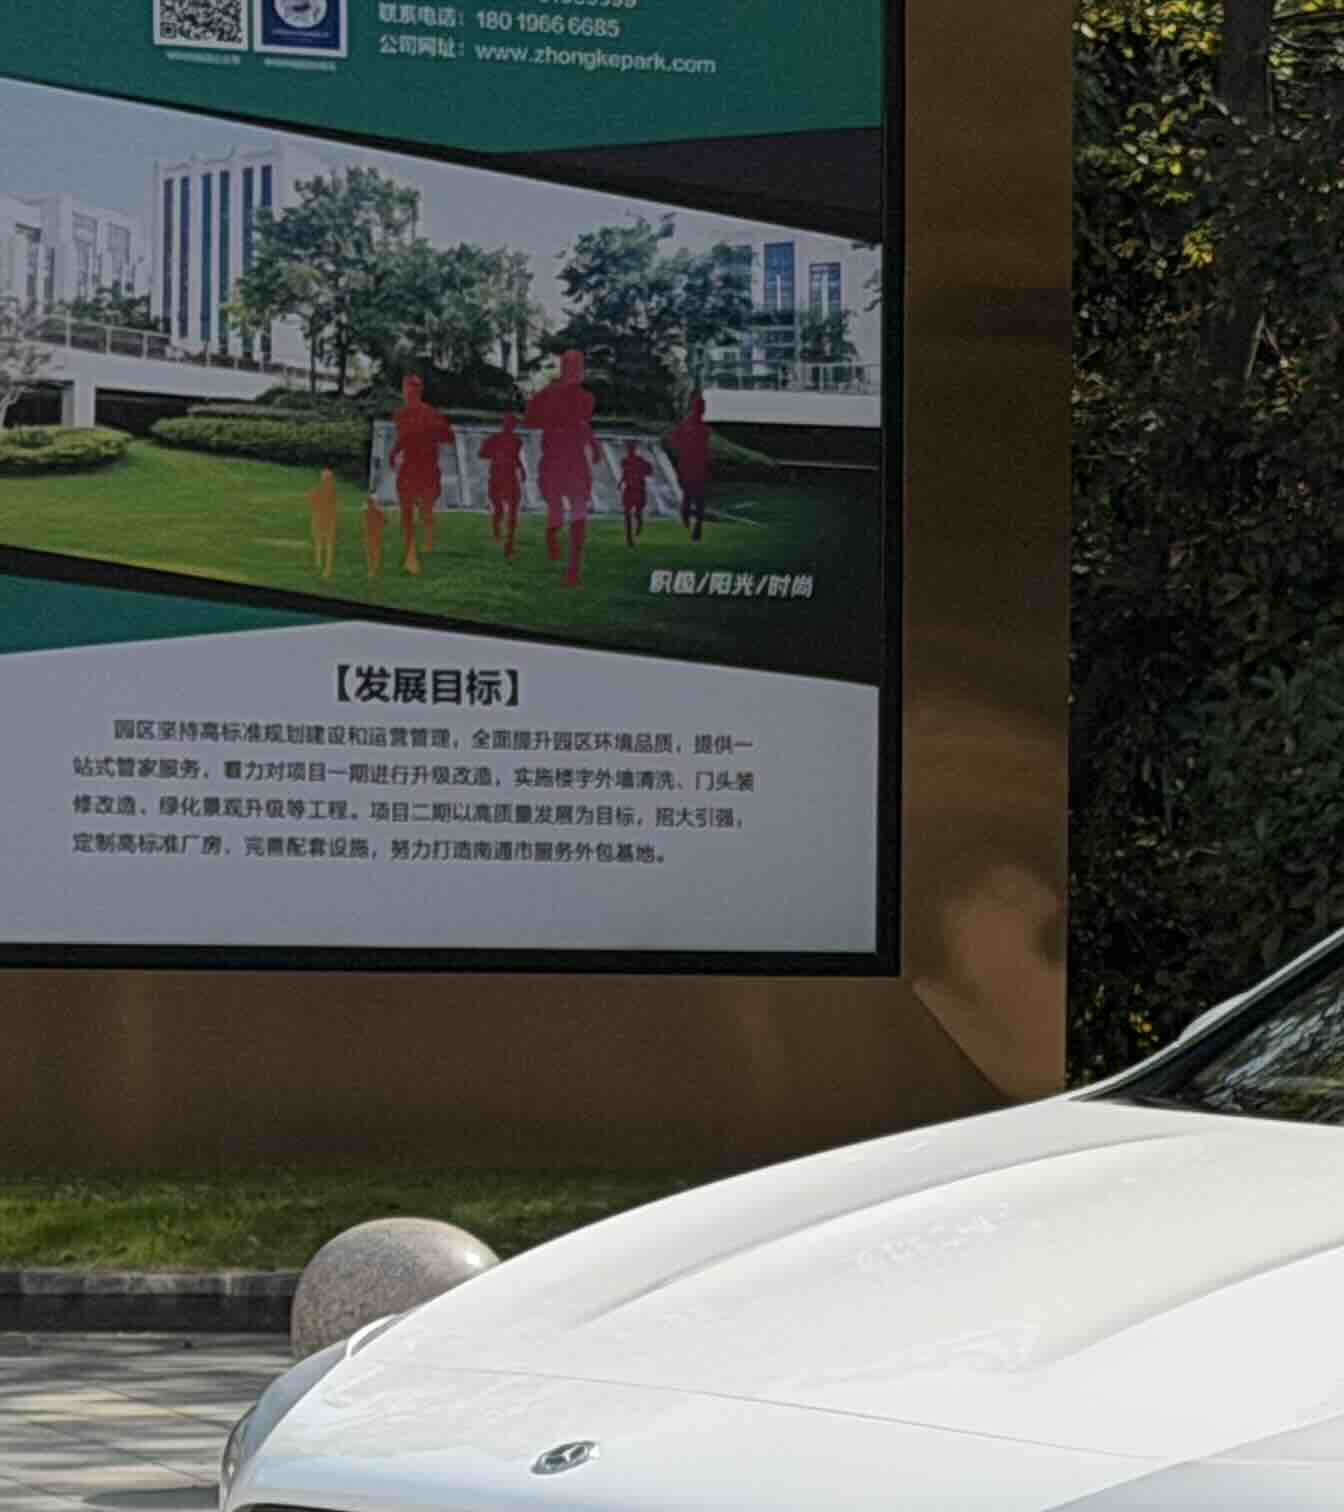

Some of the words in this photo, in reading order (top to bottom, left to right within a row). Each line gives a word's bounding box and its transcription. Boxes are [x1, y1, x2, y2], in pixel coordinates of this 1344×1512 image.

[476, 10, 513, 31] 180
[474, 42, 717, 74] www.zhongkepark.com
[337, 663, 520, 706] 【发展目标】
